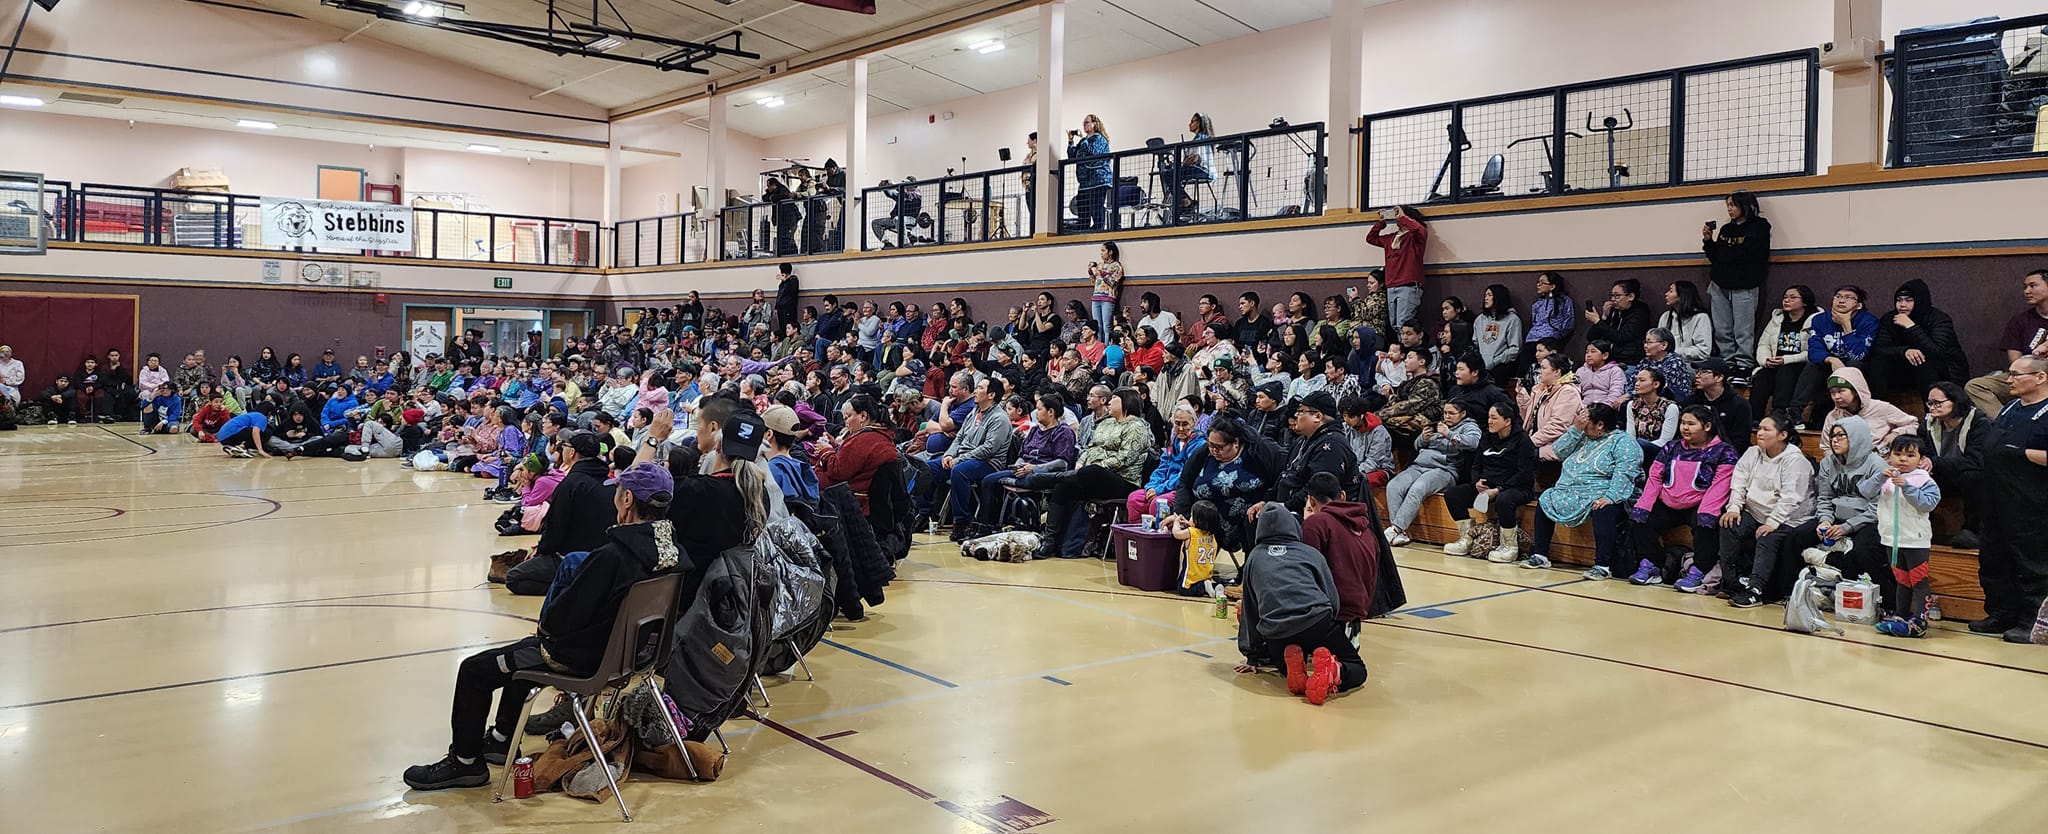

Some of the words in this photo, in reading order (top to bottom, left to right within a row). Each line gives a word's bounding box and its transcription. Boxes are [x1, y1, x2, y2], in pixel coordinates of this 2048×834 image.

[324, 212, 405, 234] Stebbins
[497, 278, 510, 287] EXIT
[1197, 546, 1214, 564] 24
